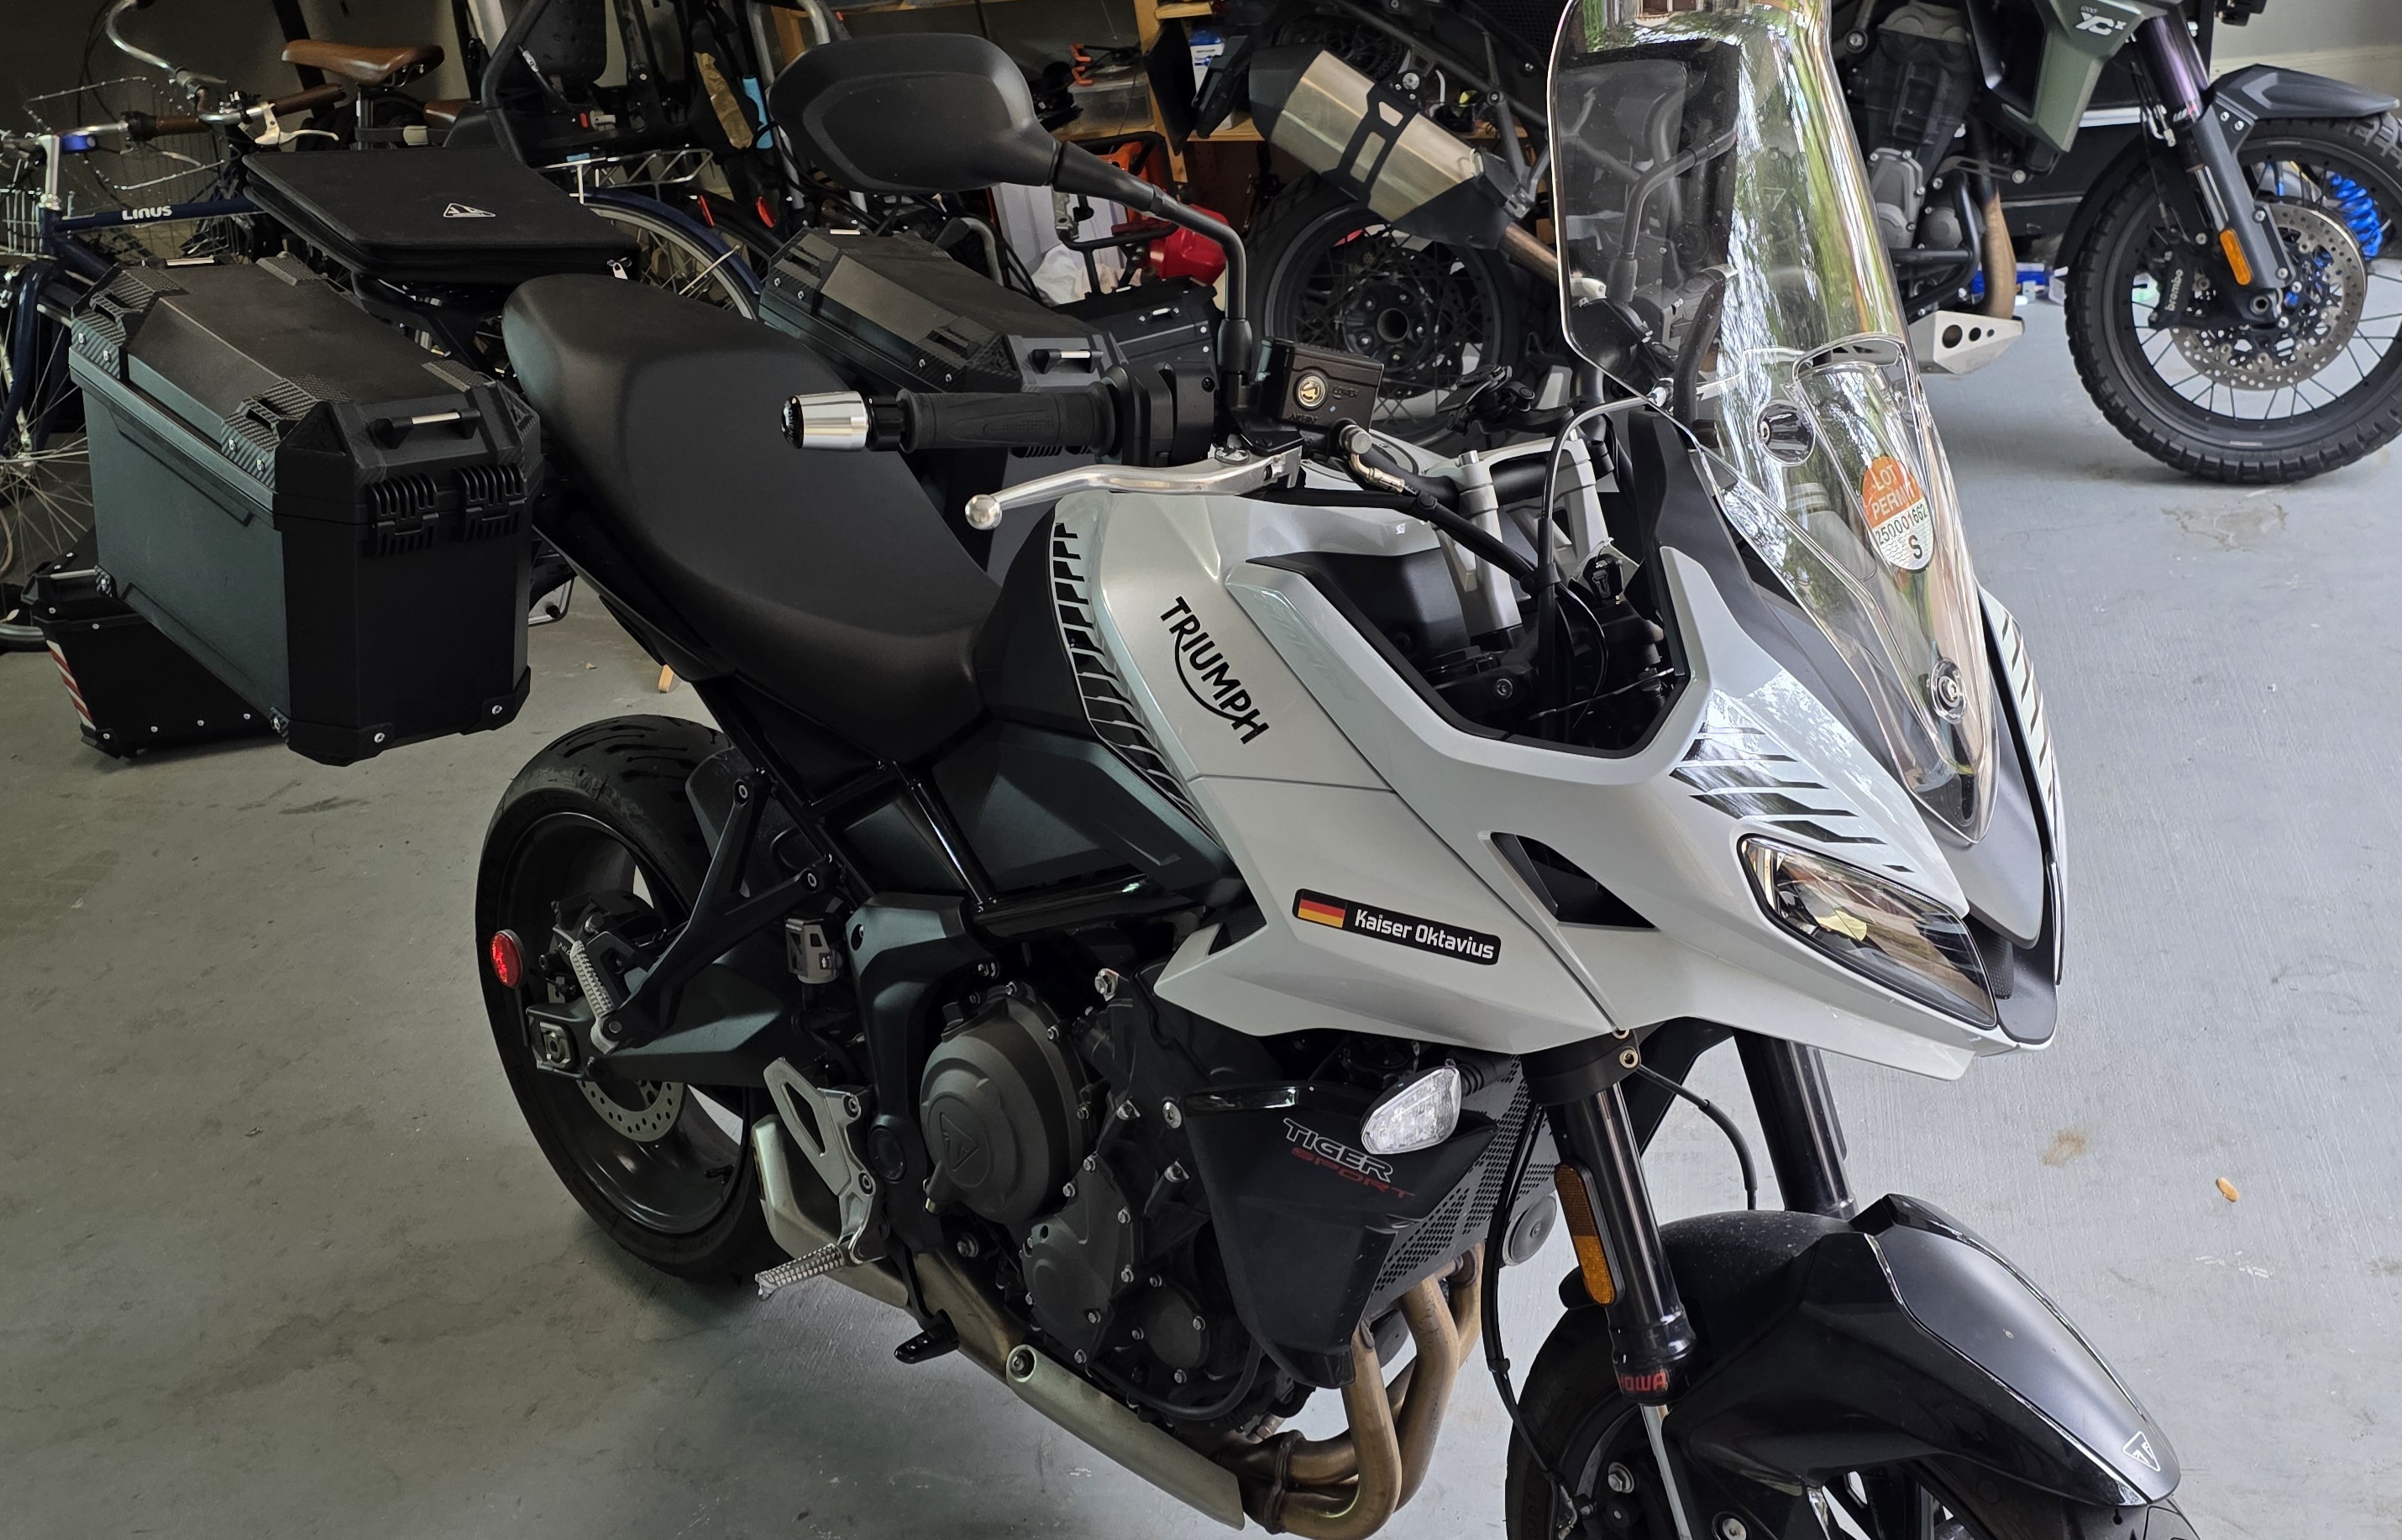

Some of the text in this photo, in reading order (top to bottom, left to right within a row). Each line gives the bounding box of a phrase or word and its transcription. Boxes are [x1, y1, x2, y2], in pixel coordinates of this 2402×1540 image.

[2164, 269, 2184, 312] brembo
[1871, 464, 1898, 491] LOT
[1871, 480, 1916, 521] PERMIT
[1907, 534, 1923, 560] S
[1160, 595, 1270, 745] TRIUMPH
[1354, 908, 1495, 960] Kaiser Oktavius
[1282, 1117, 1394, 1184] TIGER
[1291, 1146, 1416, 1199] SPORT
